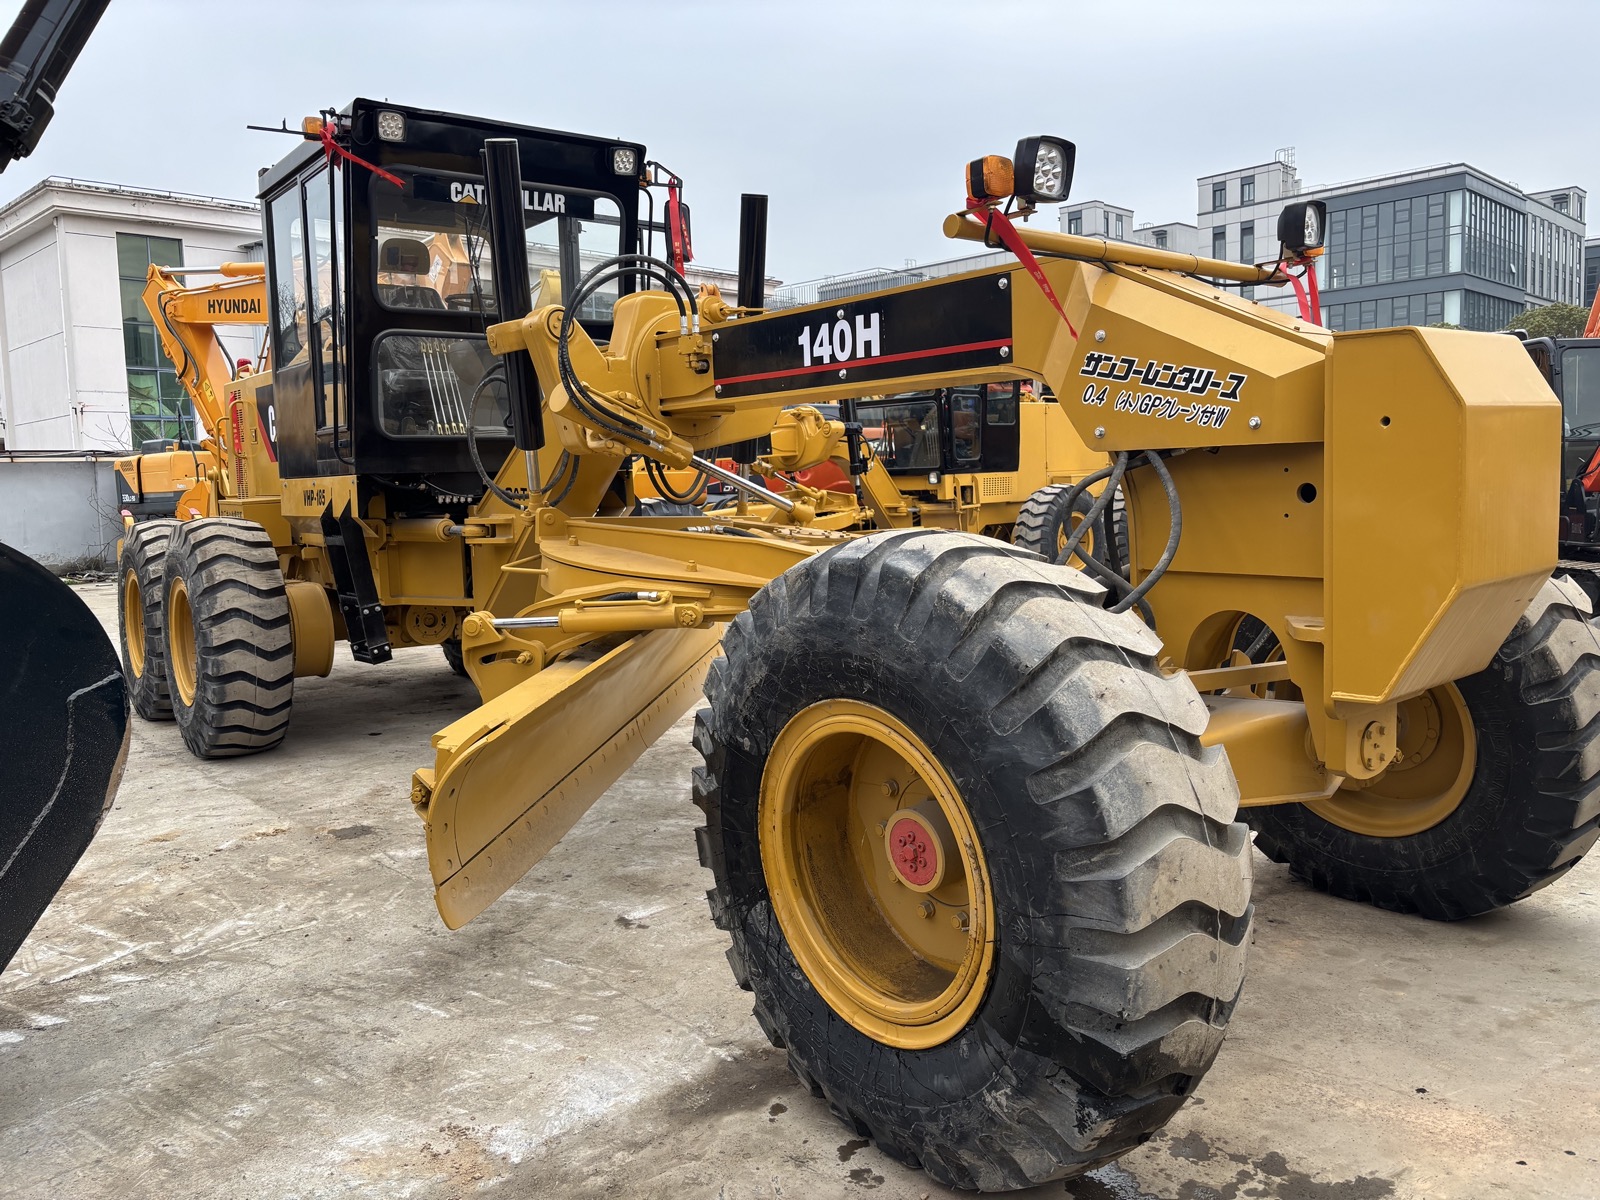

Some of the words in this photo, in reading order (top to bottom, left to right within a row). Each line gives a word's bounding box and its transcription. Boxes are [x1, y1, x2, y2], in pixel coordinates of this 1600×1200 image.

[450, 182, 566, 213] CATLLAR
[208, 299, 261, 314] HYUNDAI
[798, 312, 880, 367] 140H
[1080, 352, 1248, 401] サンコーレンタリース
[1082, 383, 1109, 406] 0.4
